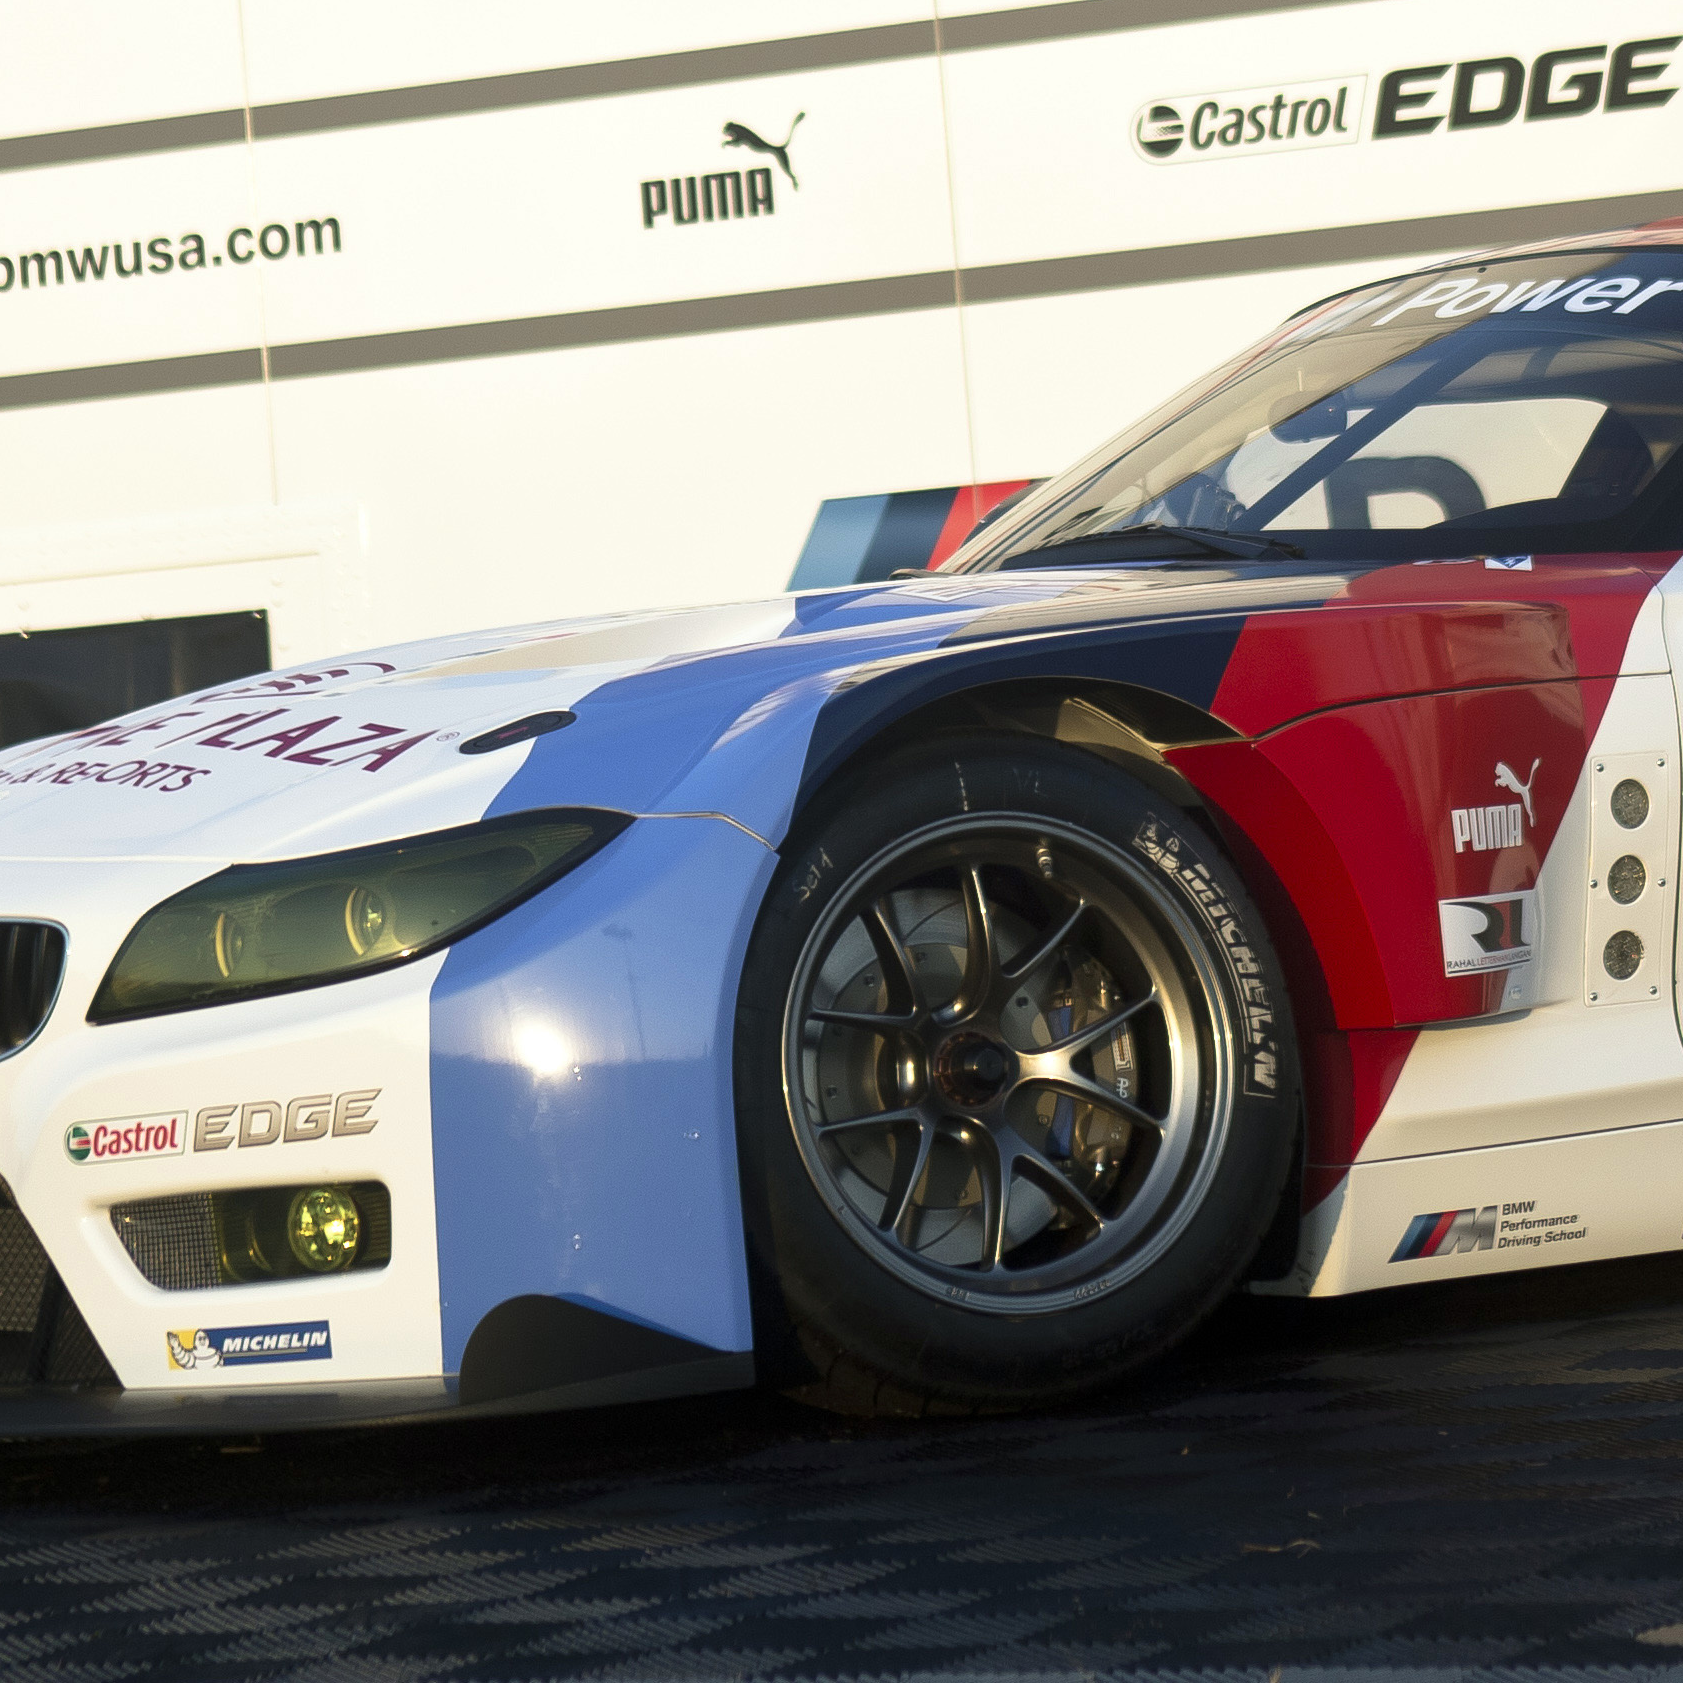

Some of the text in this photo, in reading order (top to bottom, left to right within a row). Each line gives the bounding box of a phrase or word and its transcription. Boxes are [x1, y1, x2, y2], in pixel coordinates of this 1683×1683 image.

[1189, 85, 1349, 152] Castrol
[639, 167, 776, 230] PUMA
[37, 759, 212, 793] REORTS
[1450, 803, 1523, 854] PUMA
[1180, 862, 1279, 1091] MICHELIN
[92, 1087, 383, 1159] Castrol EDGE
[1499, 1213, 1579, 1233] Performance
[1501, 1201, 1536, 1216] BMW
[1497, 1226, 1587, 1249] Driving School
[222, 1330, 328, 1354] MICHELIN
